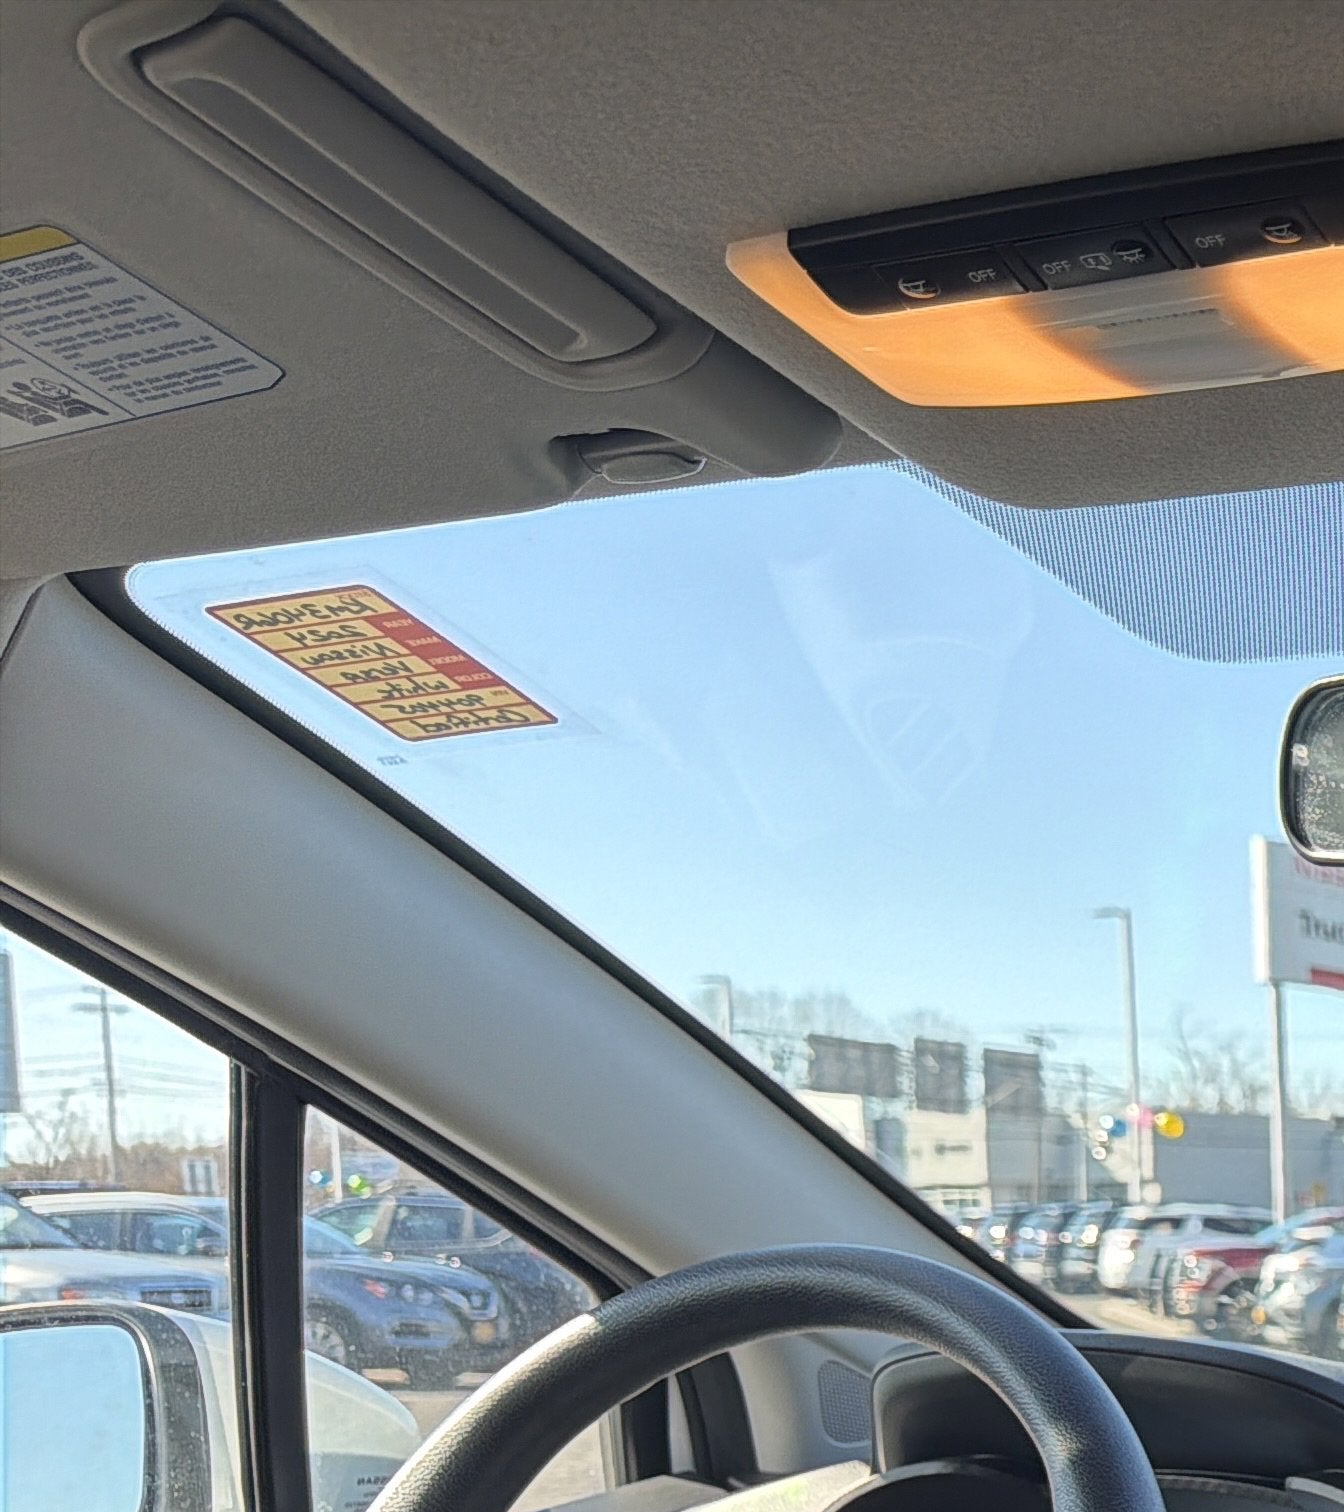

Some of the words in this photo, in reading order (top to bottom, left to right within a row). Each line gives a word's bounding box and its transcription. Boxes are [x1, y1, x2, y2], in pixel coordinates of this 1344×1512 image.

[1195, 234, 1226, 249] OFF
[1042, 260, 1072, 275] OFF
[968, 268, 999, 283] OFF
